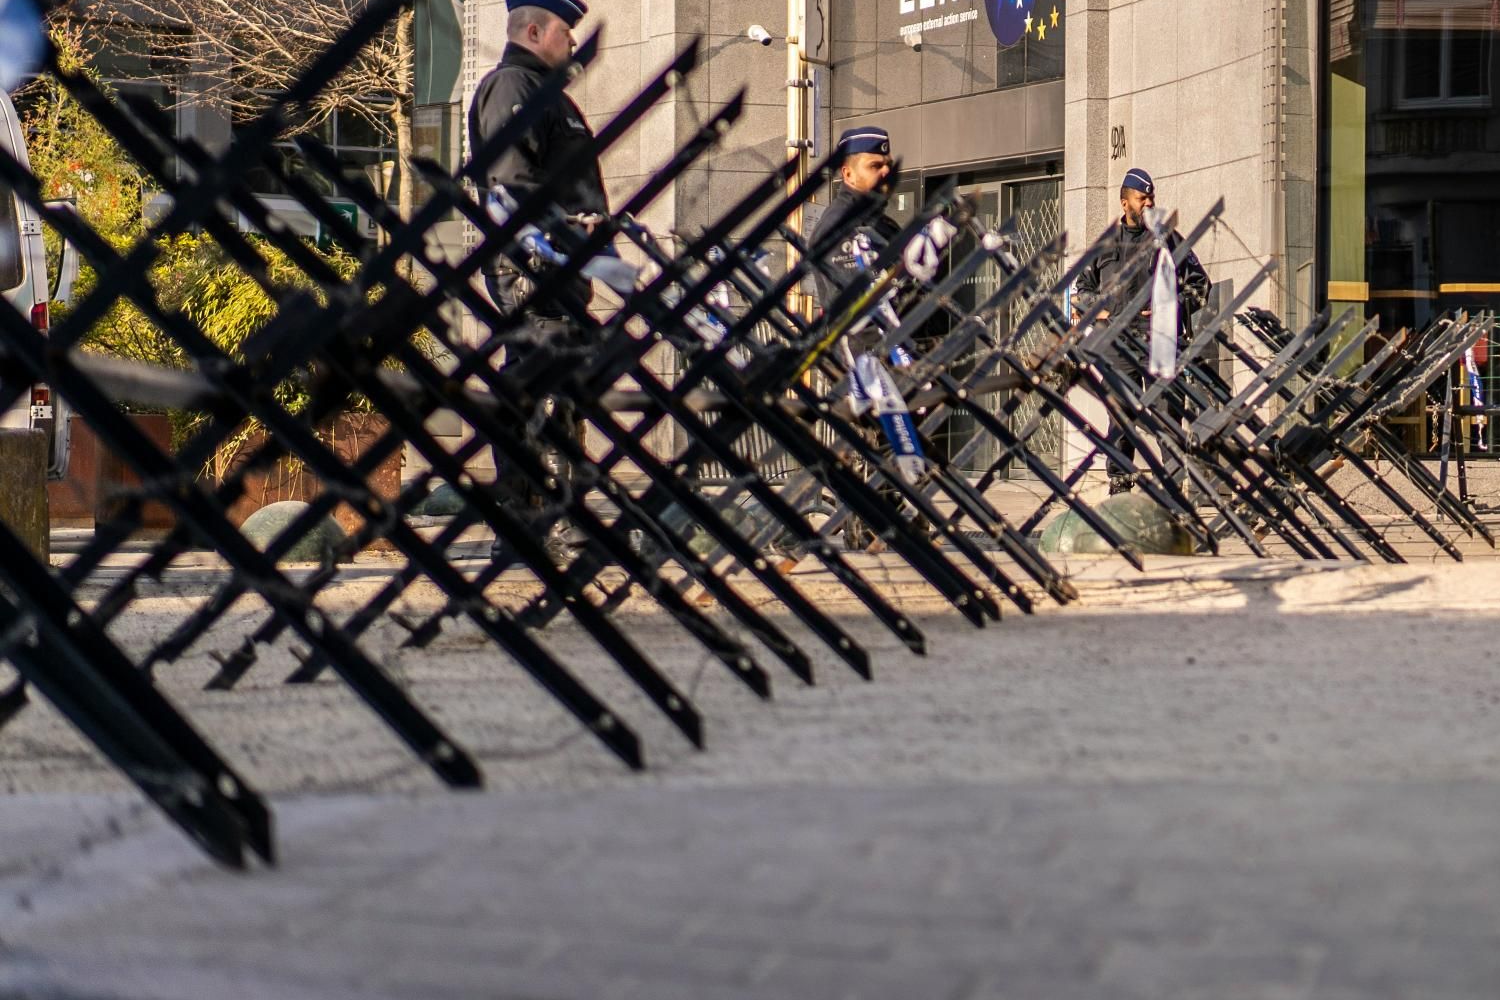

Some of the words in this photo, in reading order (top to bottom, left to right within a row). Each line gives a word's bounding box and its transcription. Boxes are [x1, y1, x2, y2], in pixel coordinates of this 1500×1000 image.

[900, 22, 922, 36] european
[923, 14, 943, 31] external
[944, 12, 959, 27] action
[960, 7, 978, 22] service
